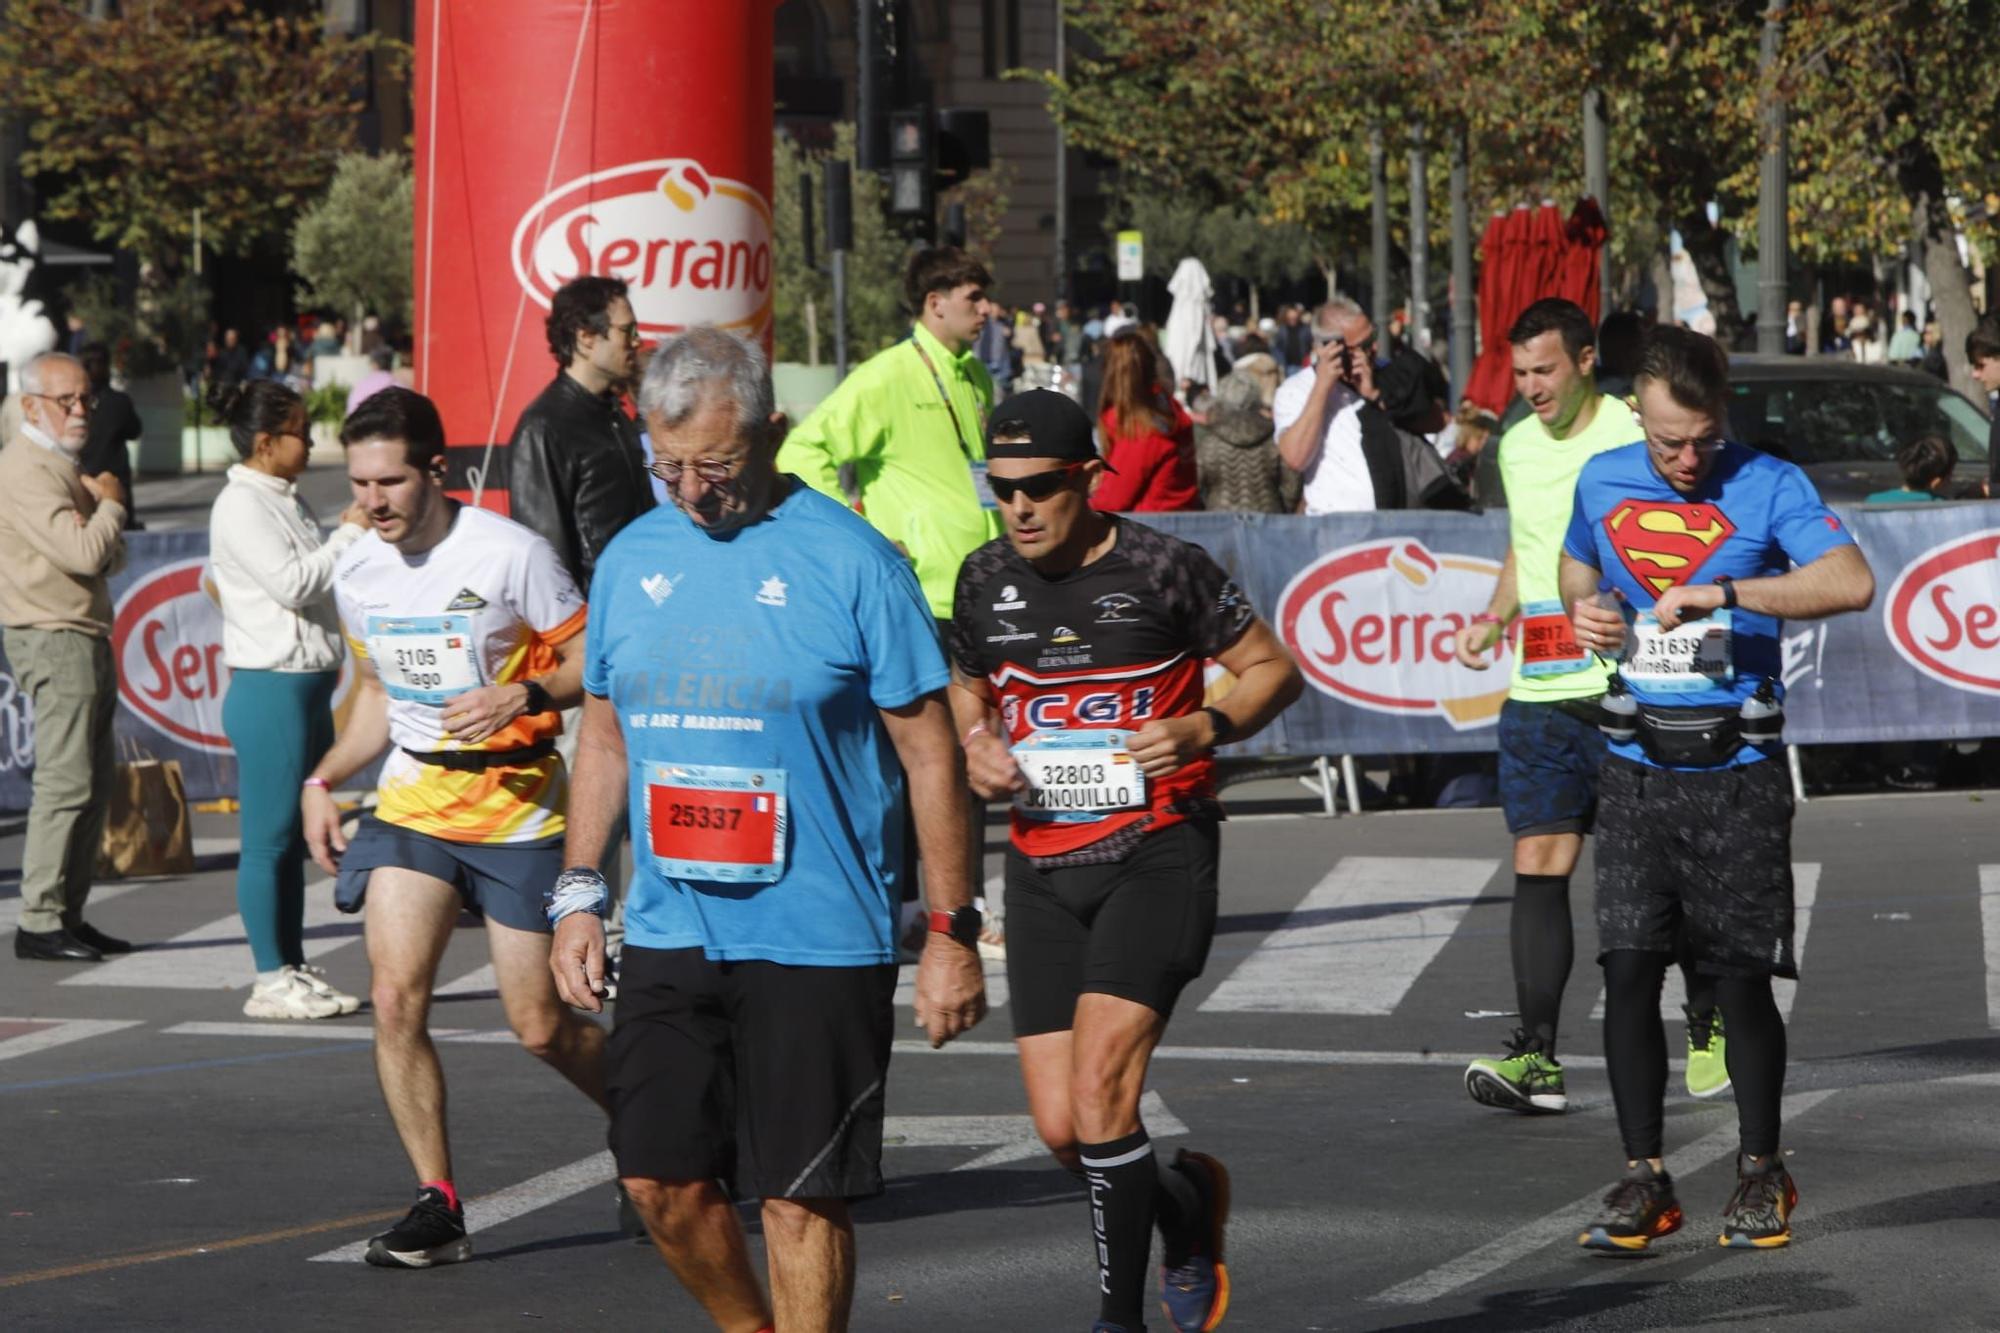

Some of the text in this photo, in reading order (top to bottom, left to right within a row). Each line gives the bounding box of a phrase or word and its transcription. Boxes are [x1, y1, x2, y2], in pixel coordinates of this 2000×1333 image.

[552, 214, 771, 291] Serrano
[1648, 635, 1702, 656] 31639
[395, 648, 438, 666] 3105
[400, 667, 442, 690] Tiago
[629, 713, 764, 732] WE ARE MARATHON
[1043, 764, 1105, 785] 32803
[1024, 786, 1130, 808] JUNQUILLO
[669, 803, 743, 831] 25337
